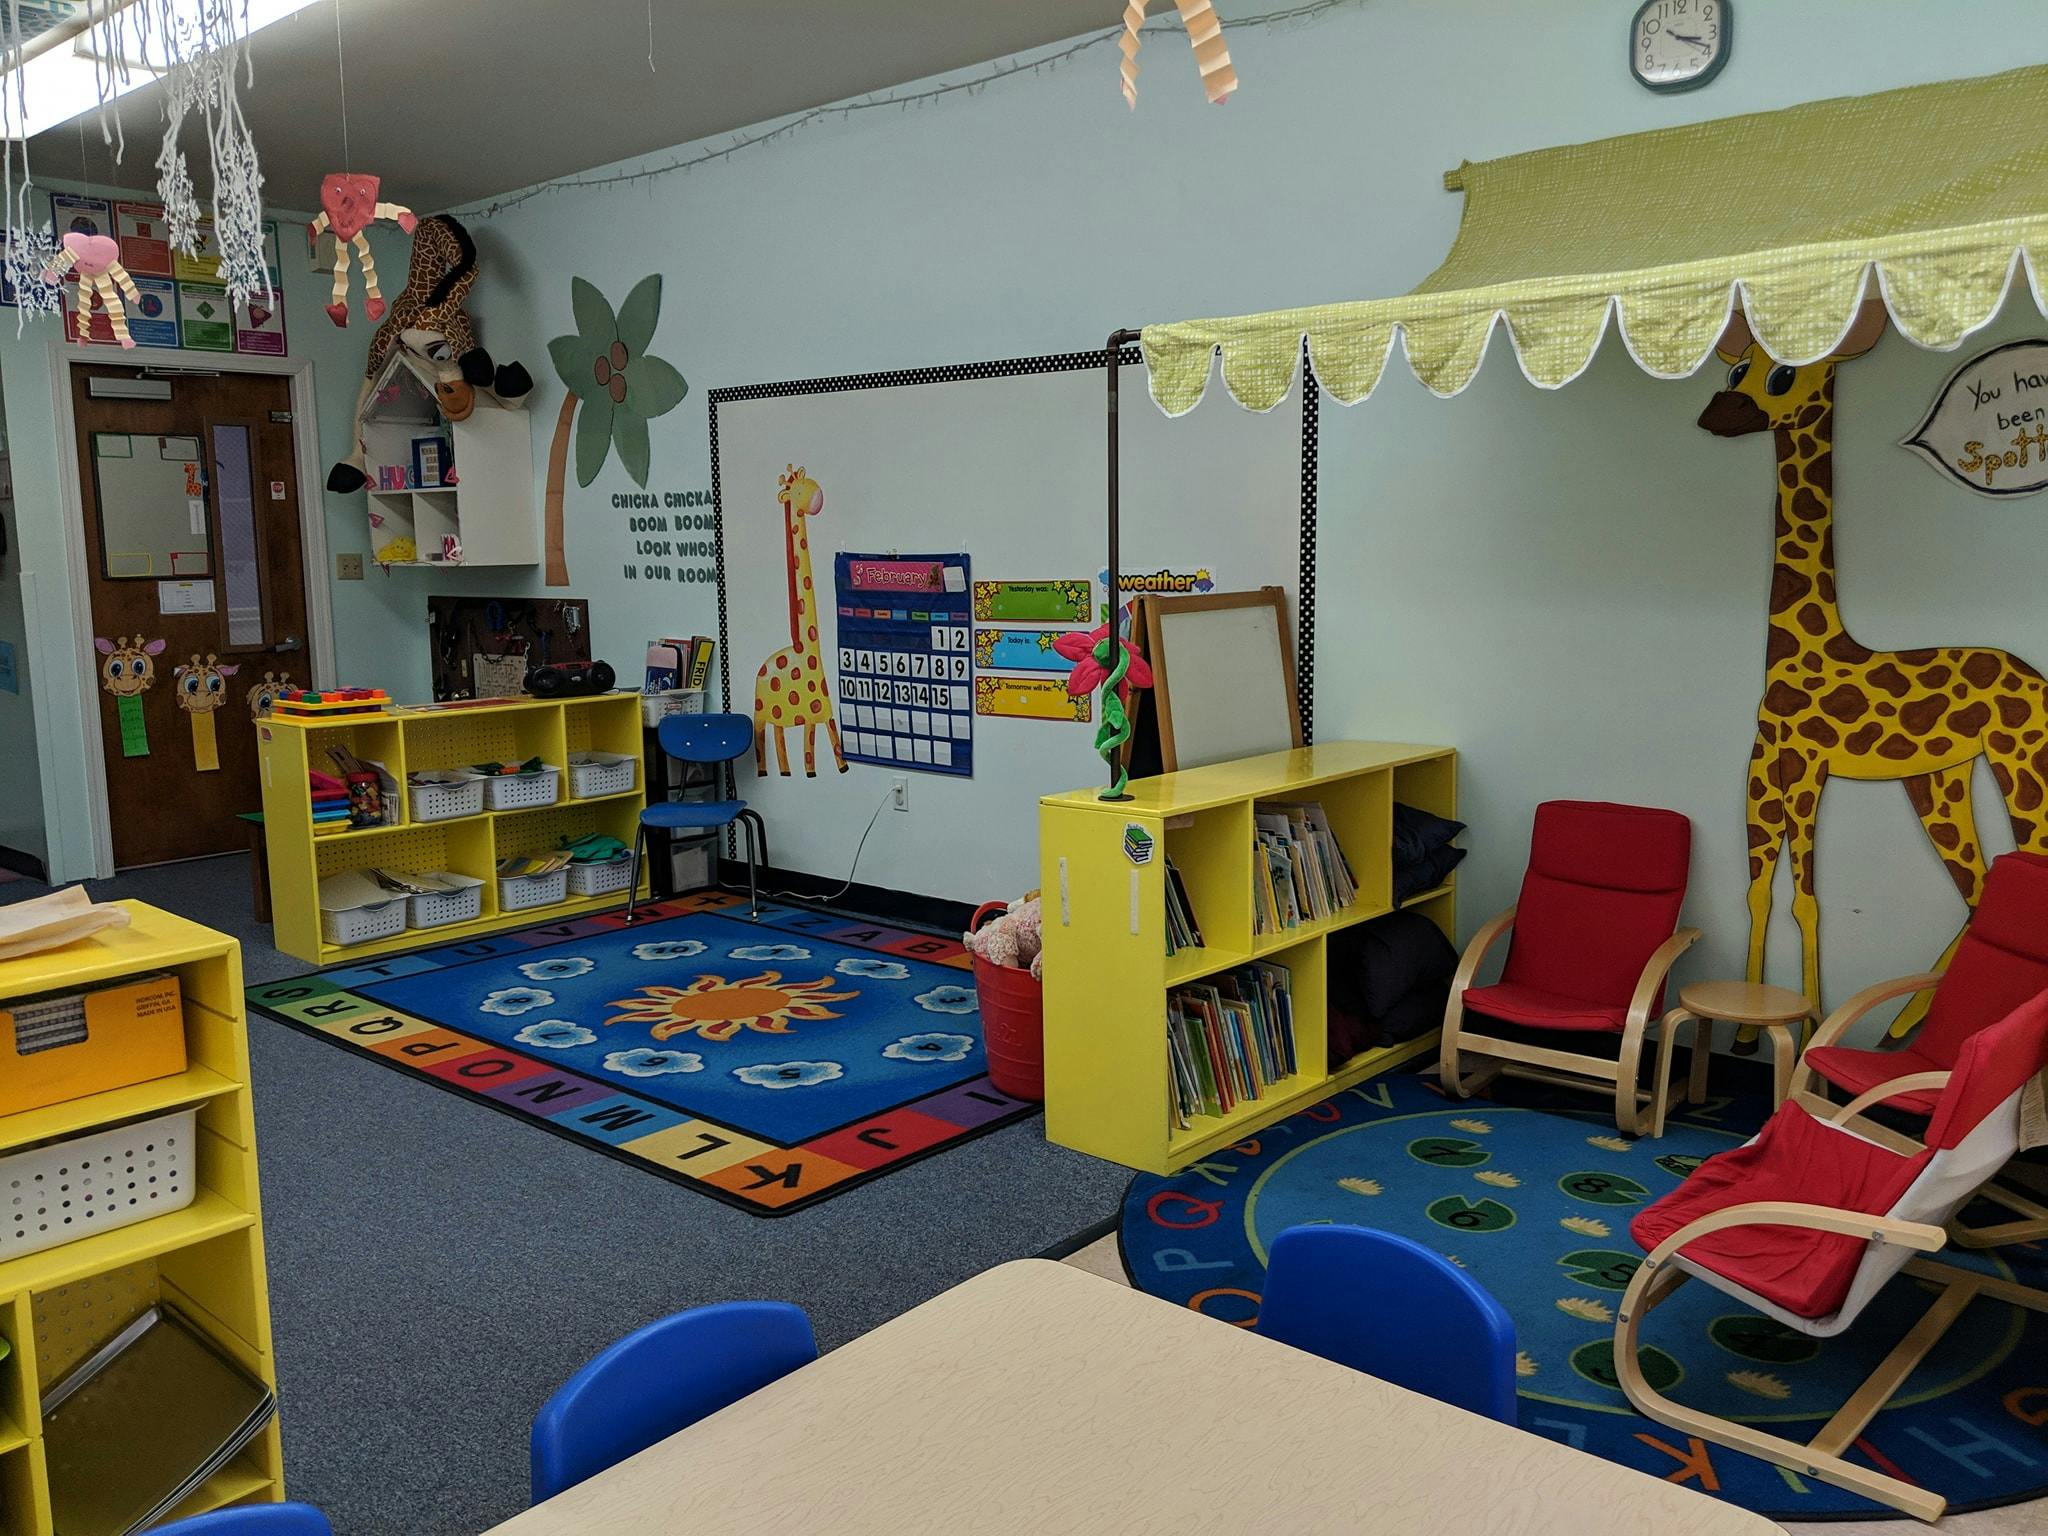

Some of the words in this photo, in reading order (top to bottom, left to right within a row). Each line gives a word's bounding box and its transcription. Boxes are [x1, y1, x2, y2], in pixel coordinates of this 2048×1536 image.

[1659, 3, 1669, 19] 11
[1673, 0, 1687, 15] 12
[1703, 5, 1713, 21] 2
[1642, 19, 1661, 36] 10
[1708, 24, 1717, 40] 3
[1641, 37, 1652, 53] 9
[1644, 55, 1654, 70] 8
[1966, 379, 2000, 411] You
[1997, 407, 2045, 430] been
[1957, 424, 2048, 486] Spott
[611, 493, 659, 509] CHICKA
[664, 490, 713, 508] CHICKA
[629, 516, 667, 532] BOOM
[674, 514, 715, 531] BOOM
[636, 540, 671, 557] LOOK
[676, 541, 716, 557] WHOS
[624, 565, 637, 580] IN
[644, 565, 671, 581] OUR
[677, 567, 718, 583] ROOM
[866, 567, 928, 589] February
[1118, 569, 1197, 592] weather
[1008, 585, 1034, 593] Yesterday
[937, 630, 944, 647] 1
[955, 630, 965, 649] 2
[1007, 637, 1024, 645] Today
[693, 661, 706, 686] FRID
[843, 651, 852, 668] 3
[861, 653, 870, 670] 4
[880, 655, 888, 672] 5
[896, 656, 906, 673] 6
[915, 657, 924, 674] 7
[935, 659, 944, 676] 8
[955, 660, 965, 678] 9
[841, 679, 855, 697] 10
[858, 680, 870, 698] 11
[875, 682, 890, 700] 12
[895, 684, 910, 703] 13
[912, 685, 928, 704] 14
[932, 687, 948, 706] 15
[1005, 683, 1031, 691] Tomorrow
[539, 926, 575, 937] V
[791, 917, 832, 928] Z
[844, 930, 883, 942] A
[453, 944, 497, 956] U
[905, 942, 946, 954] B
[354, 964, 394, 976] T
[262, 987, 313, 999] S
[302, 1000, 359, 1018] R
[350, 1016, 404, 1035] Q
[401, 1042, 460, 1056] P
[458, 1060, 514, 1077] O
[514, 1080, 583, 1104] N
[965, 1091, 1009, 1107] I
[579, 1104, 657, 1132] M
[676, 1133, 732, 1160] L
[857, 1128, 900, 1150] J
[739, 1163, 802, 1190] K
[1573, 1177, 1612, 1195] 8
[1147, 1190, 1224, 1229] Q
[1153, 1248, 1234, 1272] P
[1903, 1416, 2039, 1479] H
[1632, 1432, 1721, 1492] K
